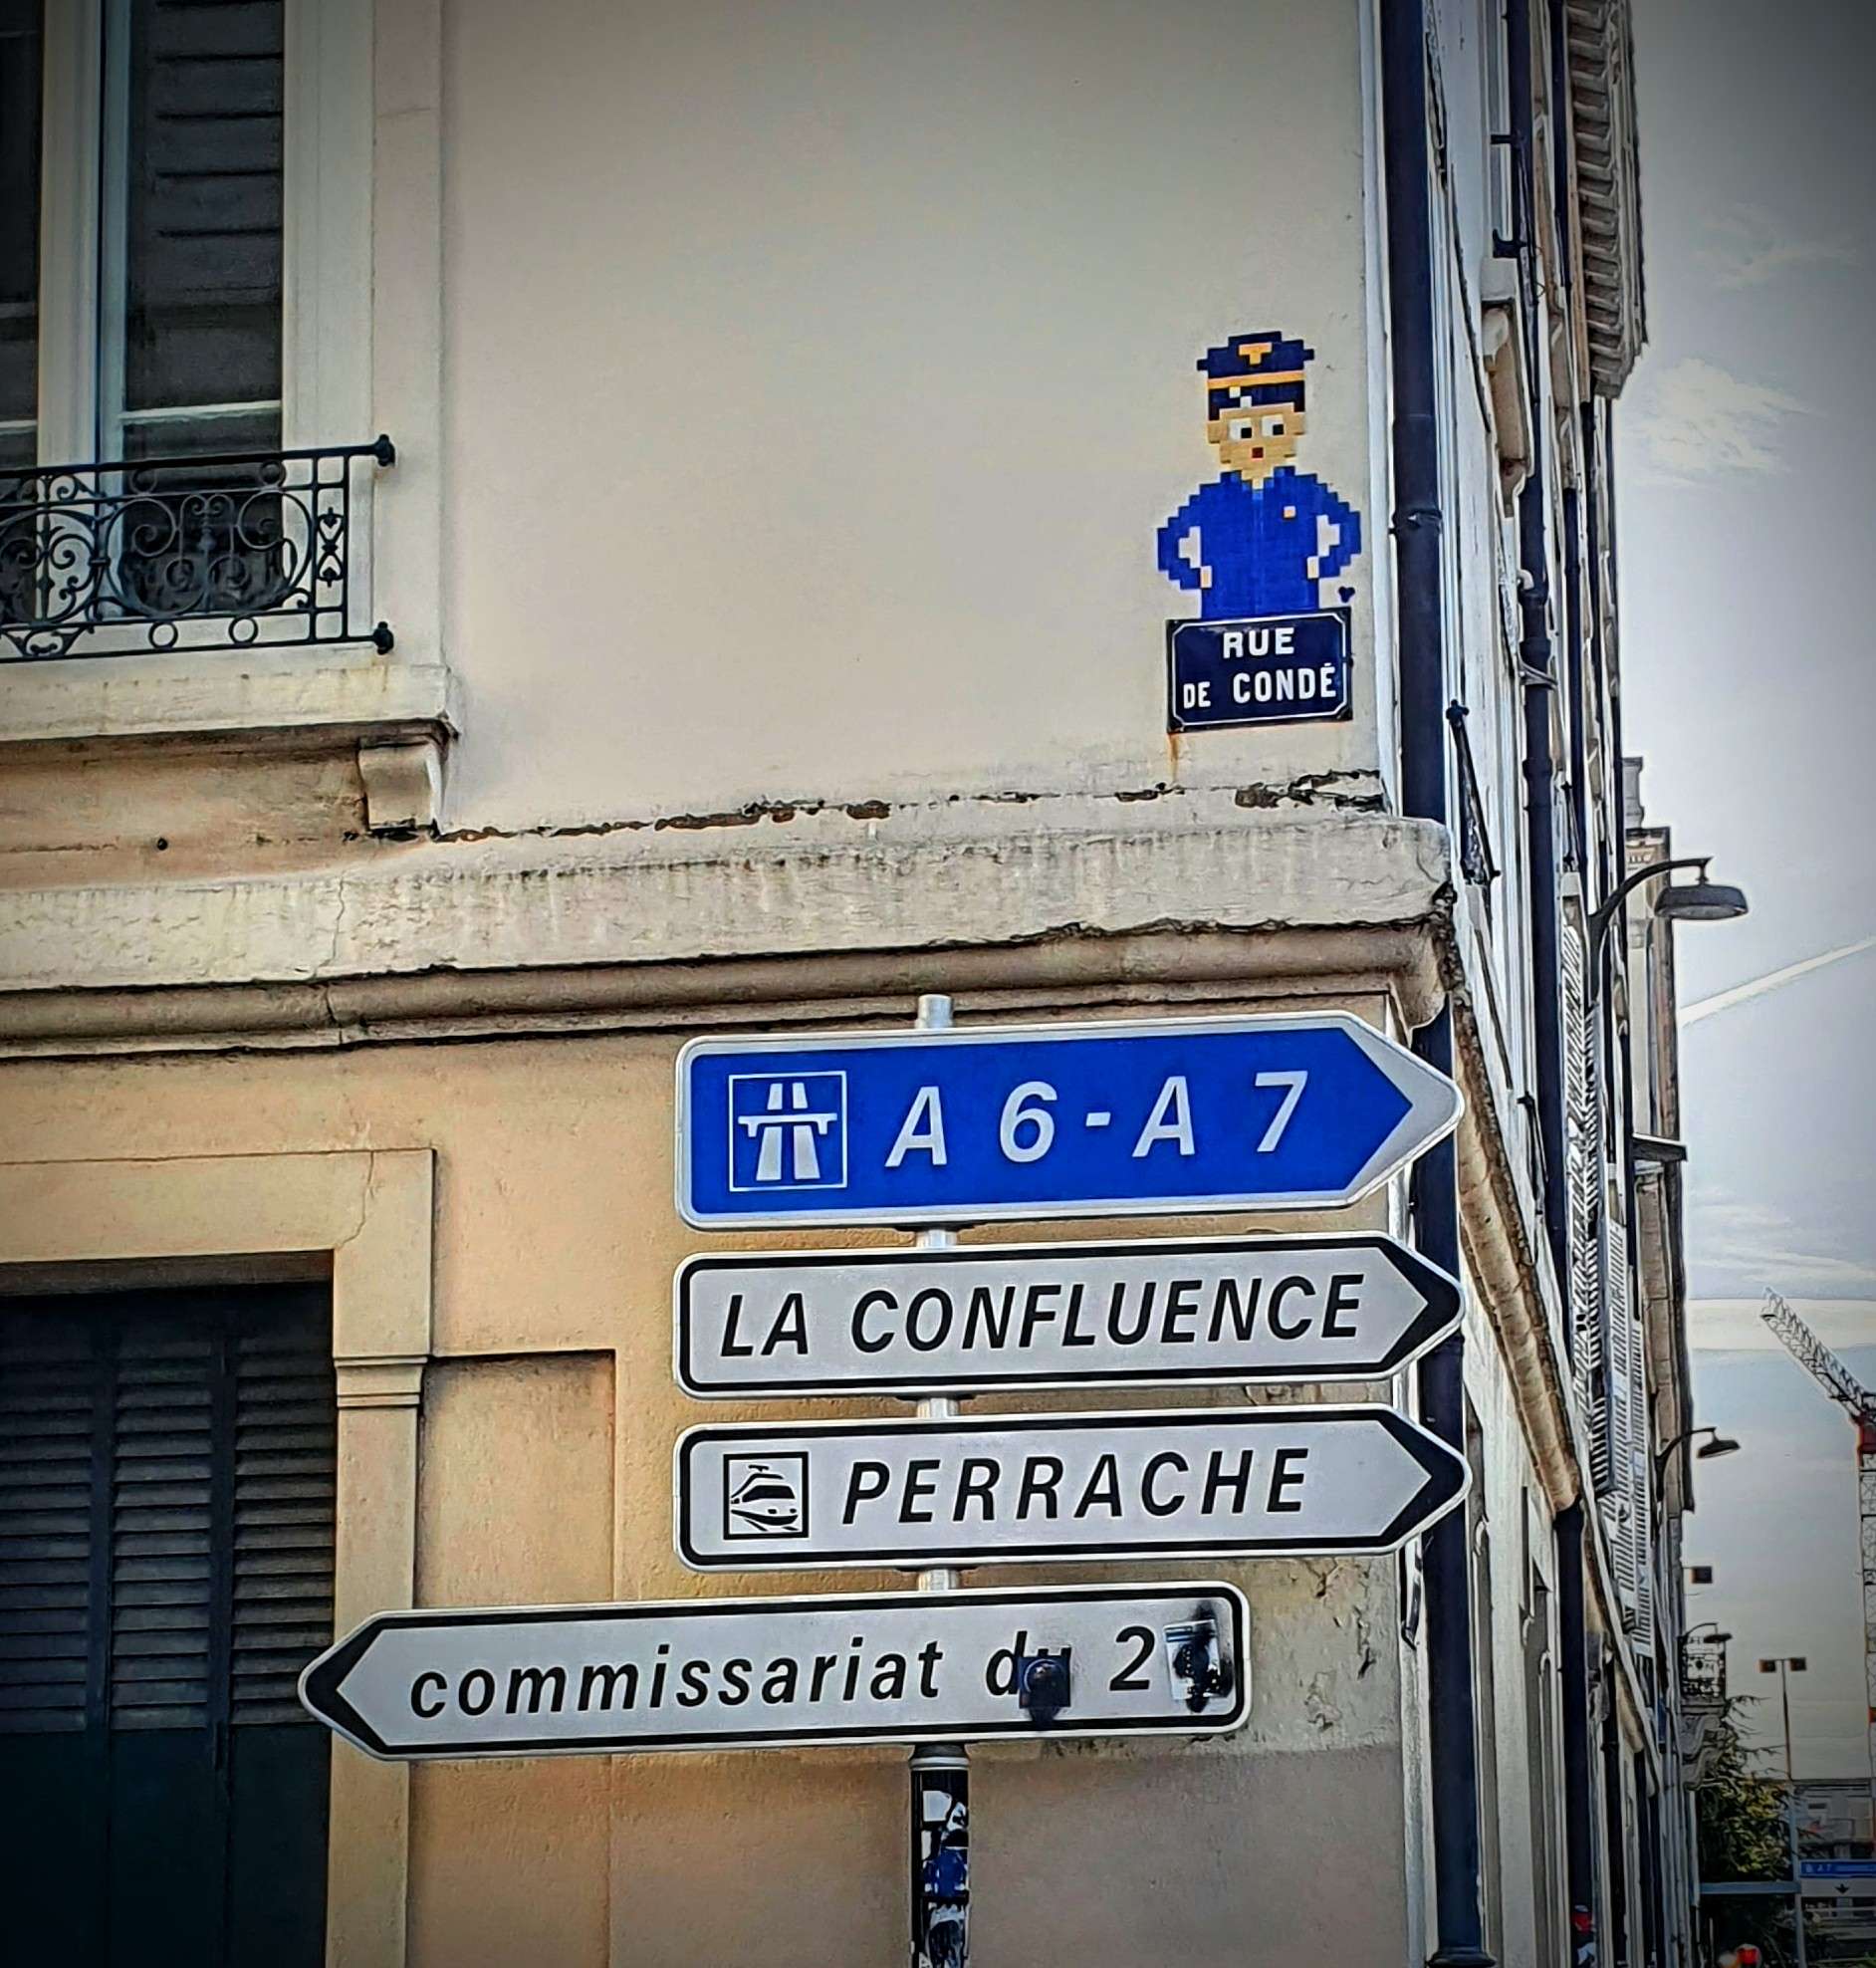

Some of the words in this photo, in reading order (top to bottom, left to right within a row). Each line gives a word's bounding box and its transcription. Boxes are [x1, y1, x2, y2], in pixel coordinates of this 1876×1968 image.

[1224, 627, 1294, 658] RUE
[1183, 681, 1212, 709] DE
[1233, 662, 1336, 704] CONDÉ
[720, 1293, 809, 1357] LA
[851, 1273, 1364, 1353] CONFLUENCE
[842, 1447, 1309, 1525] PERRACHE
[410, 1636, 944, 1719] commissariat
[985, 1630, 1072, 1695] d
